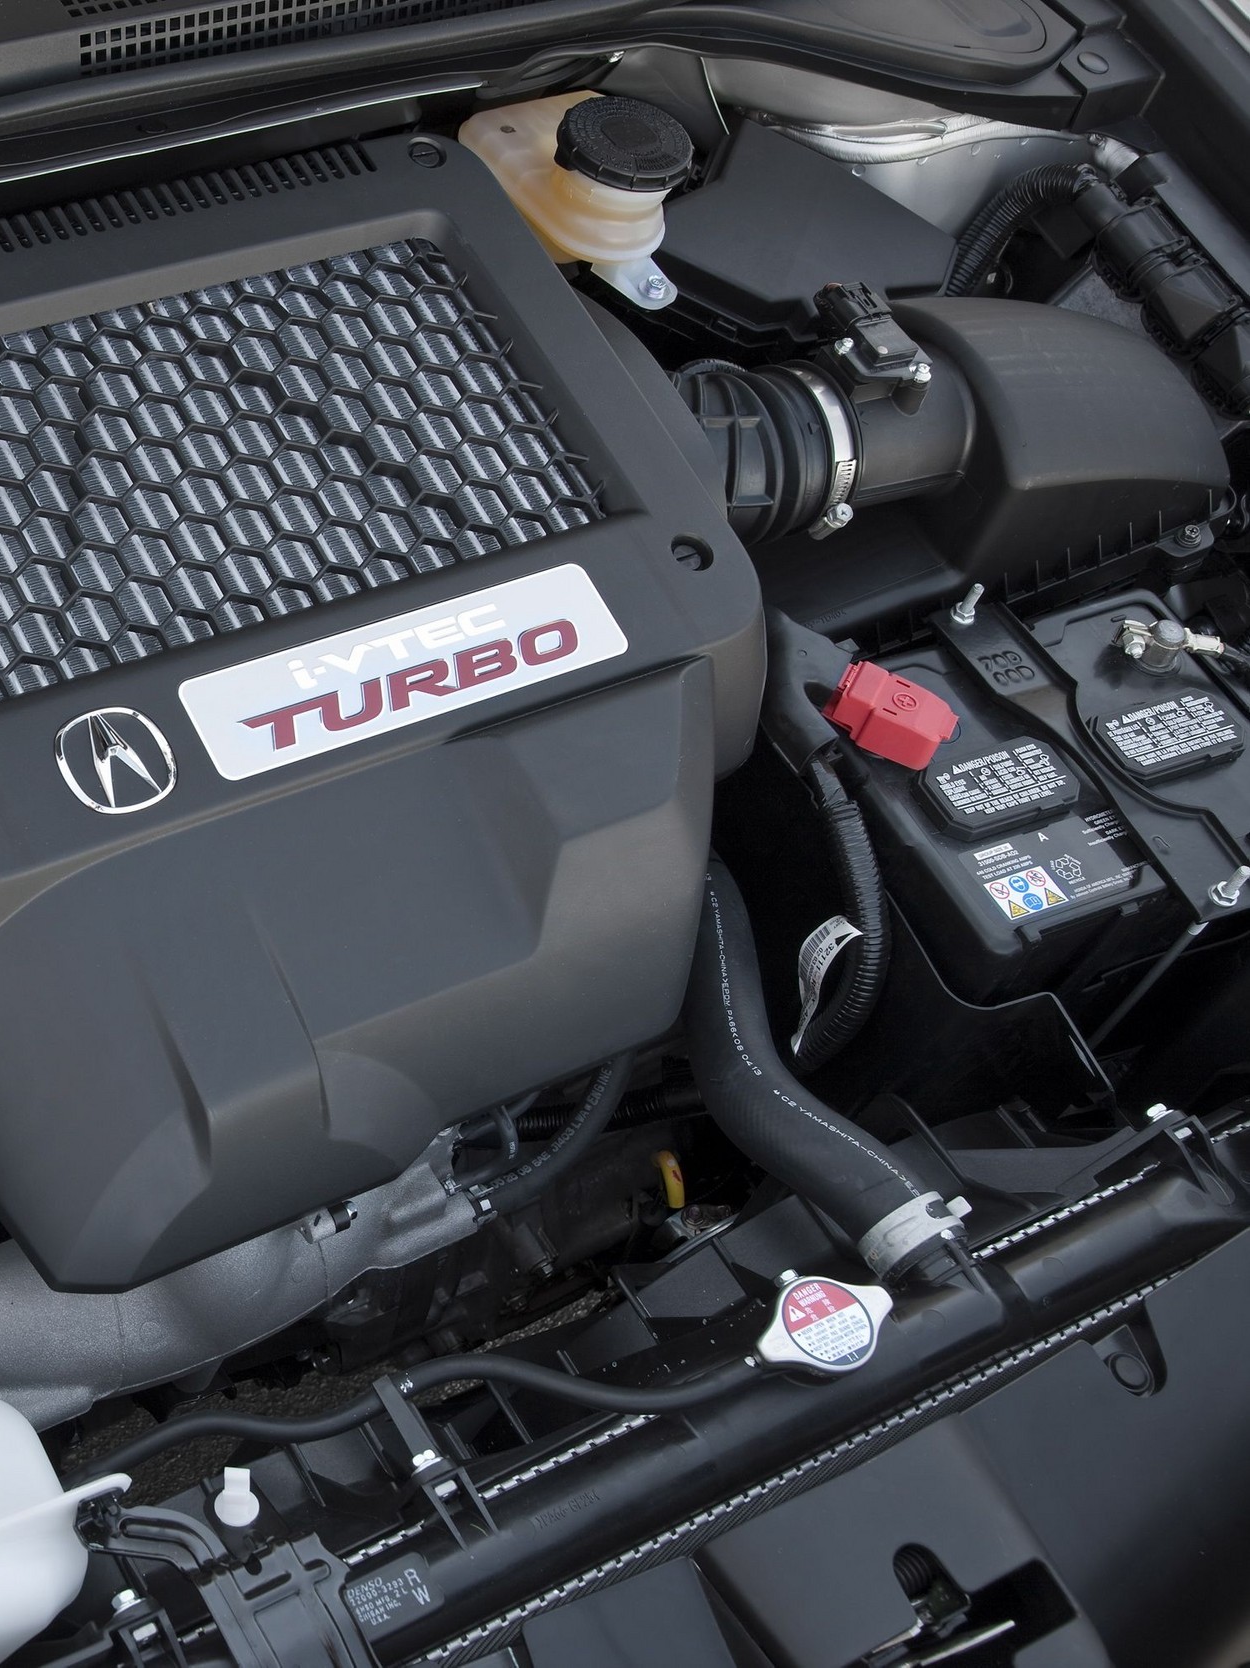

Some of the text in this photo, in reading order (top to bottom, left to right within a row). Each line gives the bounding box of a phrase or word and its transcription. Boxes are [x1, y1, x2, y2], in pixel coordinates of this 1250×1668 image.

[287, 602, 506, 691] i-VTEC
[237, 618, 579, 752] TURBO
[1127, 701, 1178, 723] DANGER/POISON
[958, 750, 1010, 771] DANGER/POISON
[1038, 832, 1049, 842] A
[982, 872, 995, 880] TEST
[994, 869, 1007, 877] LOAD
[985, 865, 1000, 874] COLD
[710, 897, 719, 908] C2
[781, 1095, 797, 1107] C2
[793, 1282, 821, 1300] DANGER
[404, 1569, 421, 1586] R
[347, 1577, 382, 1599] DENSO
[412, 1585, 430, 1605] W
